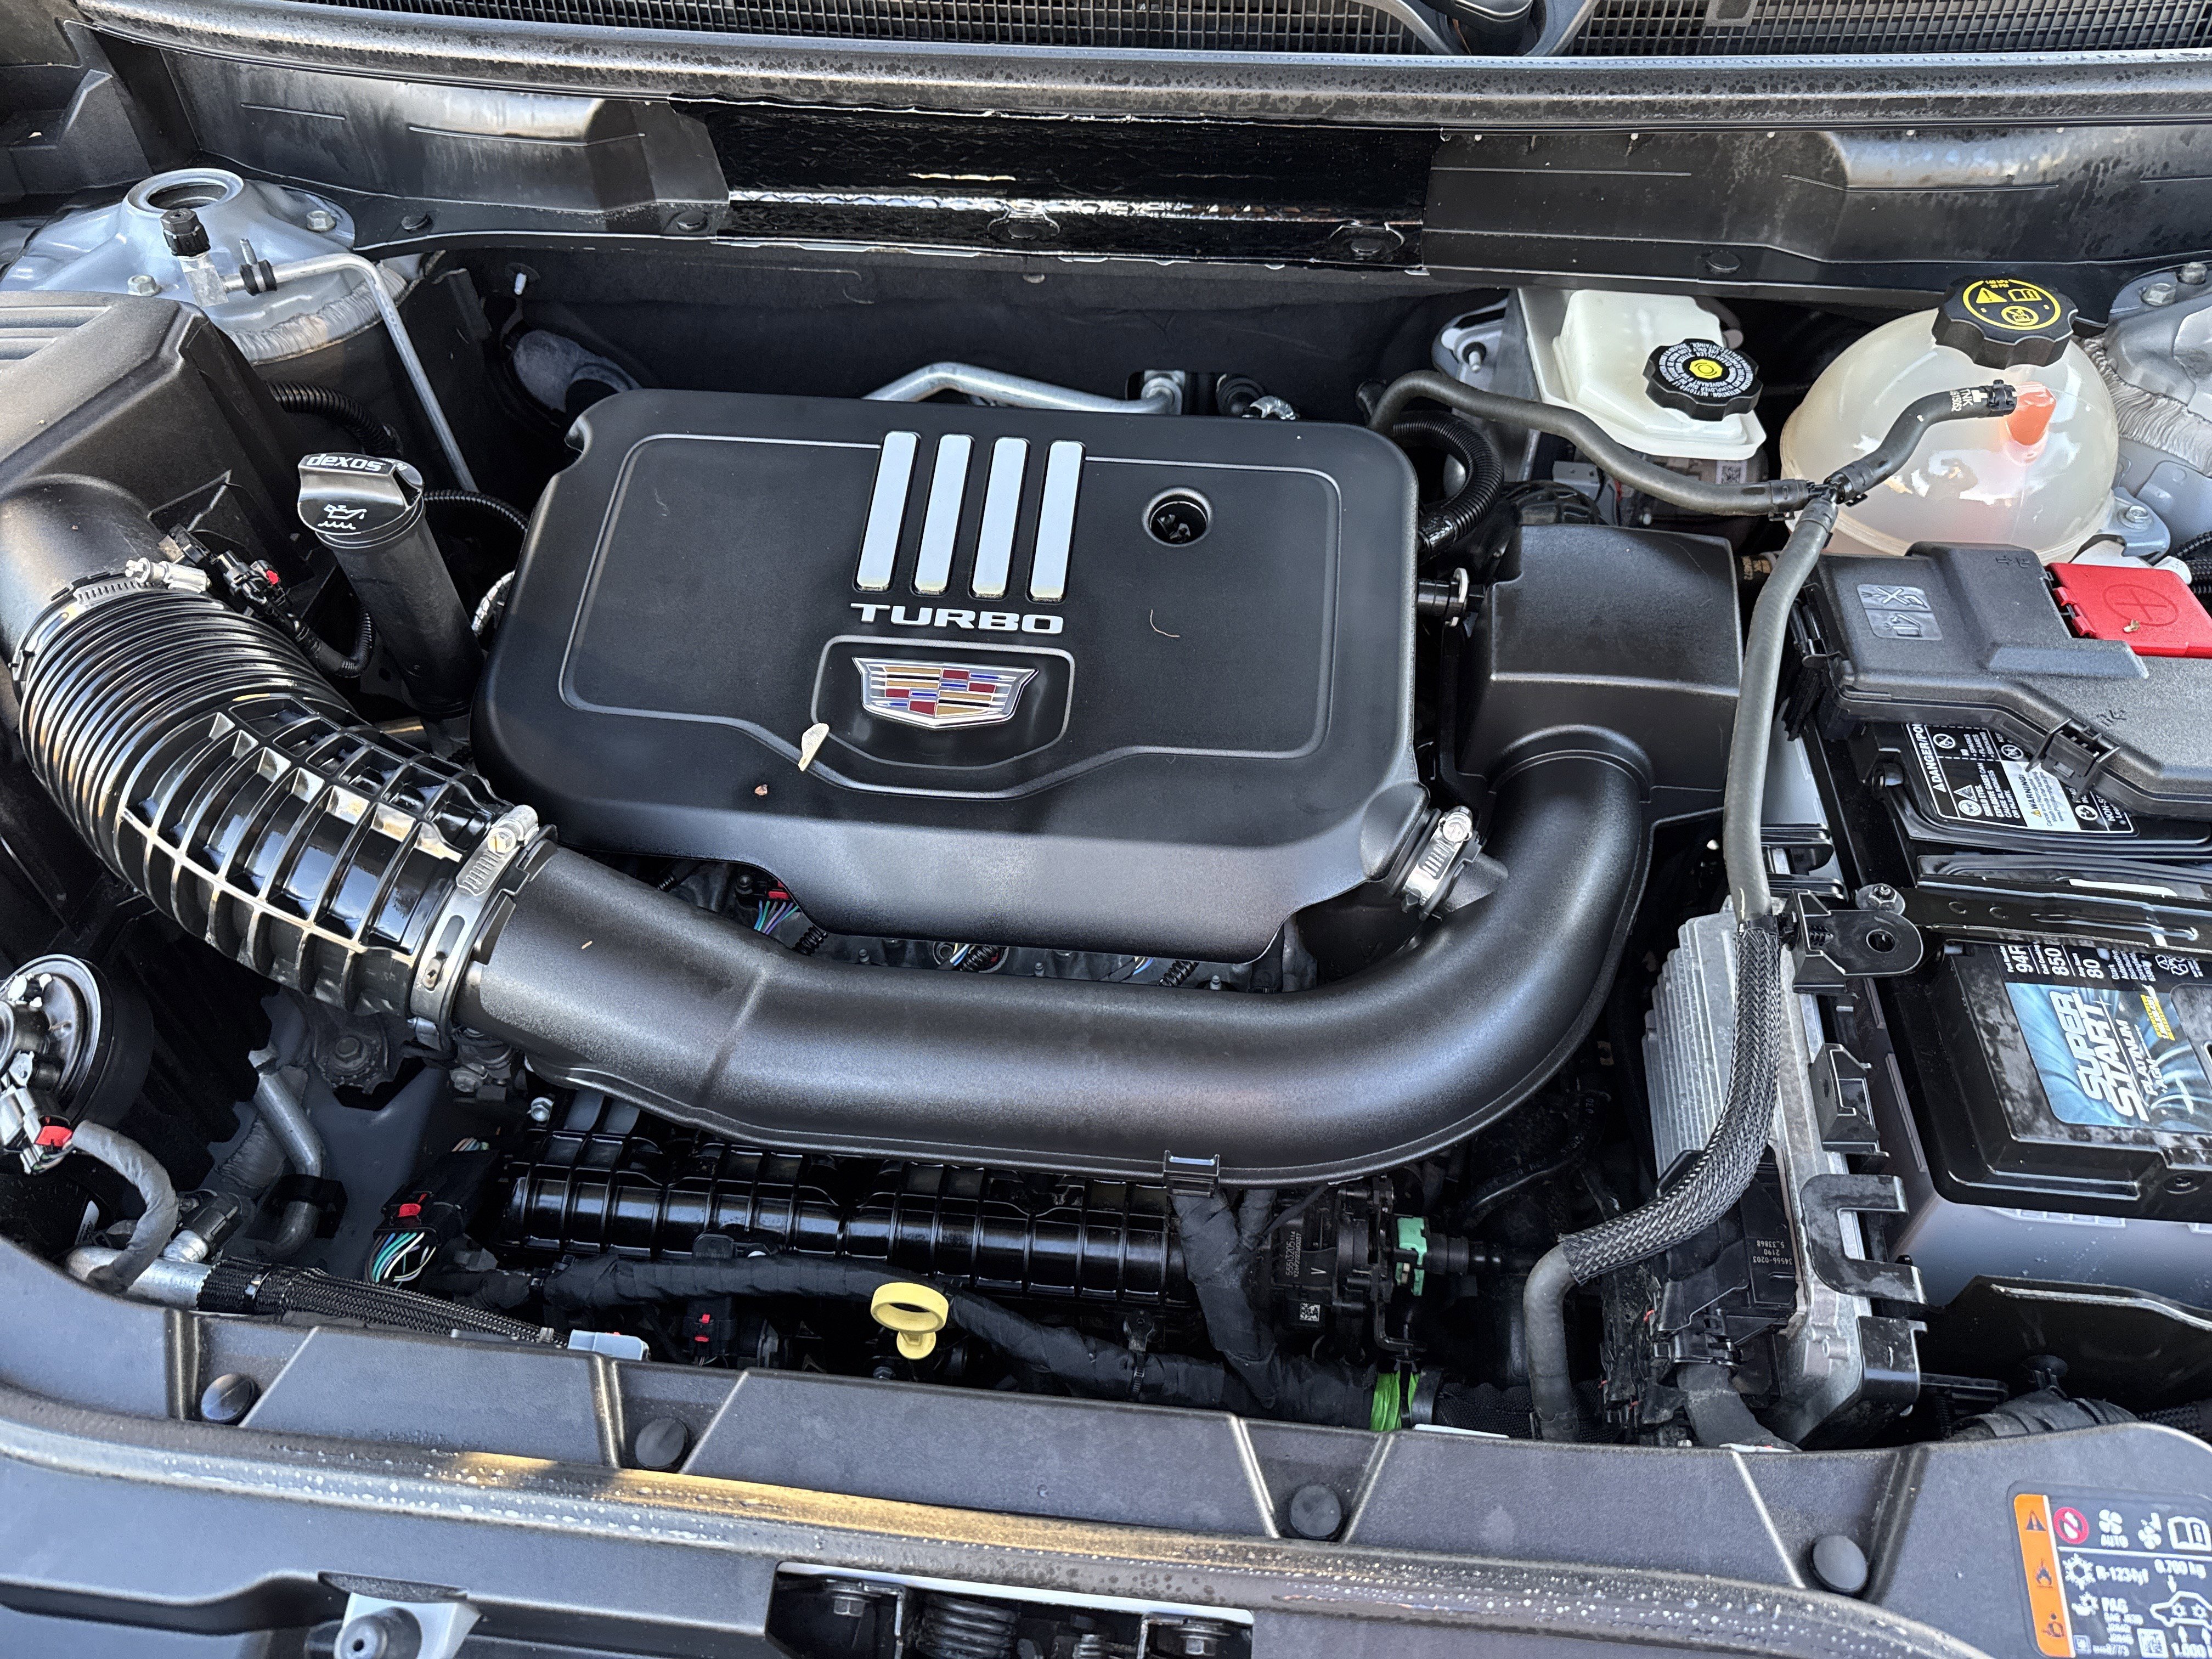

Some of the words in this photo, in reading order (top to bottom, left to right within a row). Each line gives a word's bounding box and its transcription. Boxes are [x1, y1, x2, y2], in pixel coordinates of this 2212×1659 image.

[1959, 388, 1973, 406] TNK
[306, 453, 382, 472] dexos
[850, 603, 1064, 634] TURBO
[1977, 763, 1986, 774] CAN
[1980, 799, 1994, 817] SHIELD
[2000, 799, 2012, 818] CAUSE
[2012, 810, 2021, 819] OR
[2044, 947, 2070, 977] 850
[2083, 959, 2104, 979] 80
[2108, 964, 2120, 980] Ozark
[2049, 991, 2103, 1100] SUPER
[2073, 989, 2134, 1117] START
[2115, 1019, 2158, 1096] PLATINUM
[1763, 1248, 1780, 1256] 2190
[2101, 1534, 2129, 1548] AUTO
